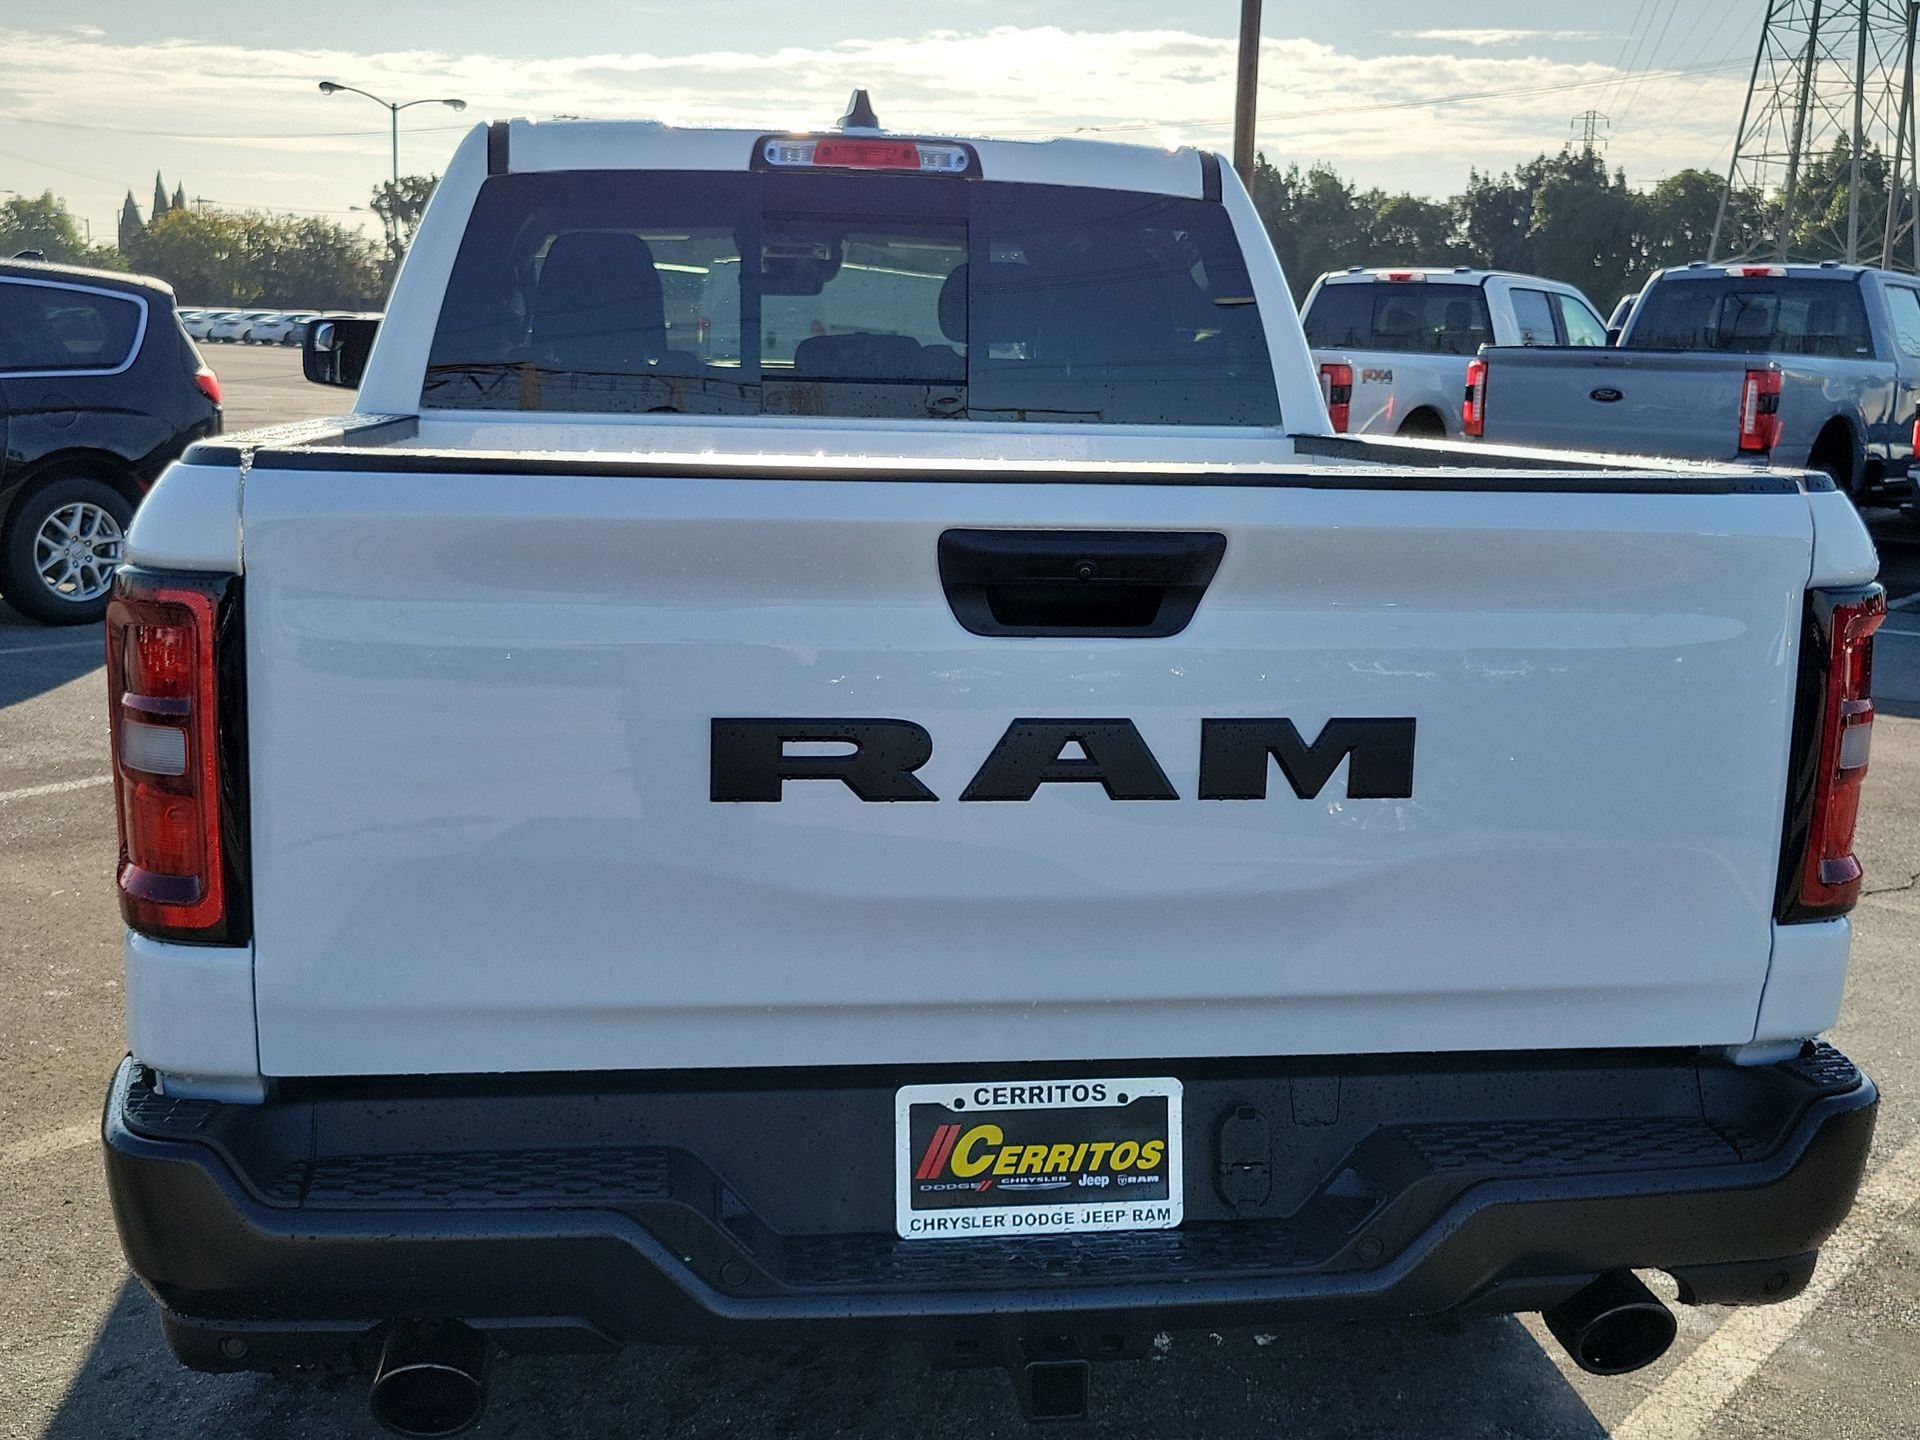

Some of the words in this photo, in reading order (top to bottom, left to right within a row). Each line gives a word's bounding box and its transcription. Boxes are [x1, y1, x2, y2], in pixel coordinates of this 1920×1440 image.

[710, 717, 1417, 802] RAM
[973, 1083, 1107, 1106] CERRITOS
[950, 1123, 1165, 1178] CERRITOS
[920, 1182, 982, 1192] DODGE
[1001, 1175, 1067, 1184] CHRYSLER
[1078, 1173, 1110, 1188] Jeep
[1127, 1174, 1160, 1184] RAM
[910, 1215, 1006, 1232] CHRYSLER
[1012, 1212, 1075, 1227] DODGE
[1081, 1209, 1126, 1224] JEEP
[1132, 1207, 1171, 1222] RAM
